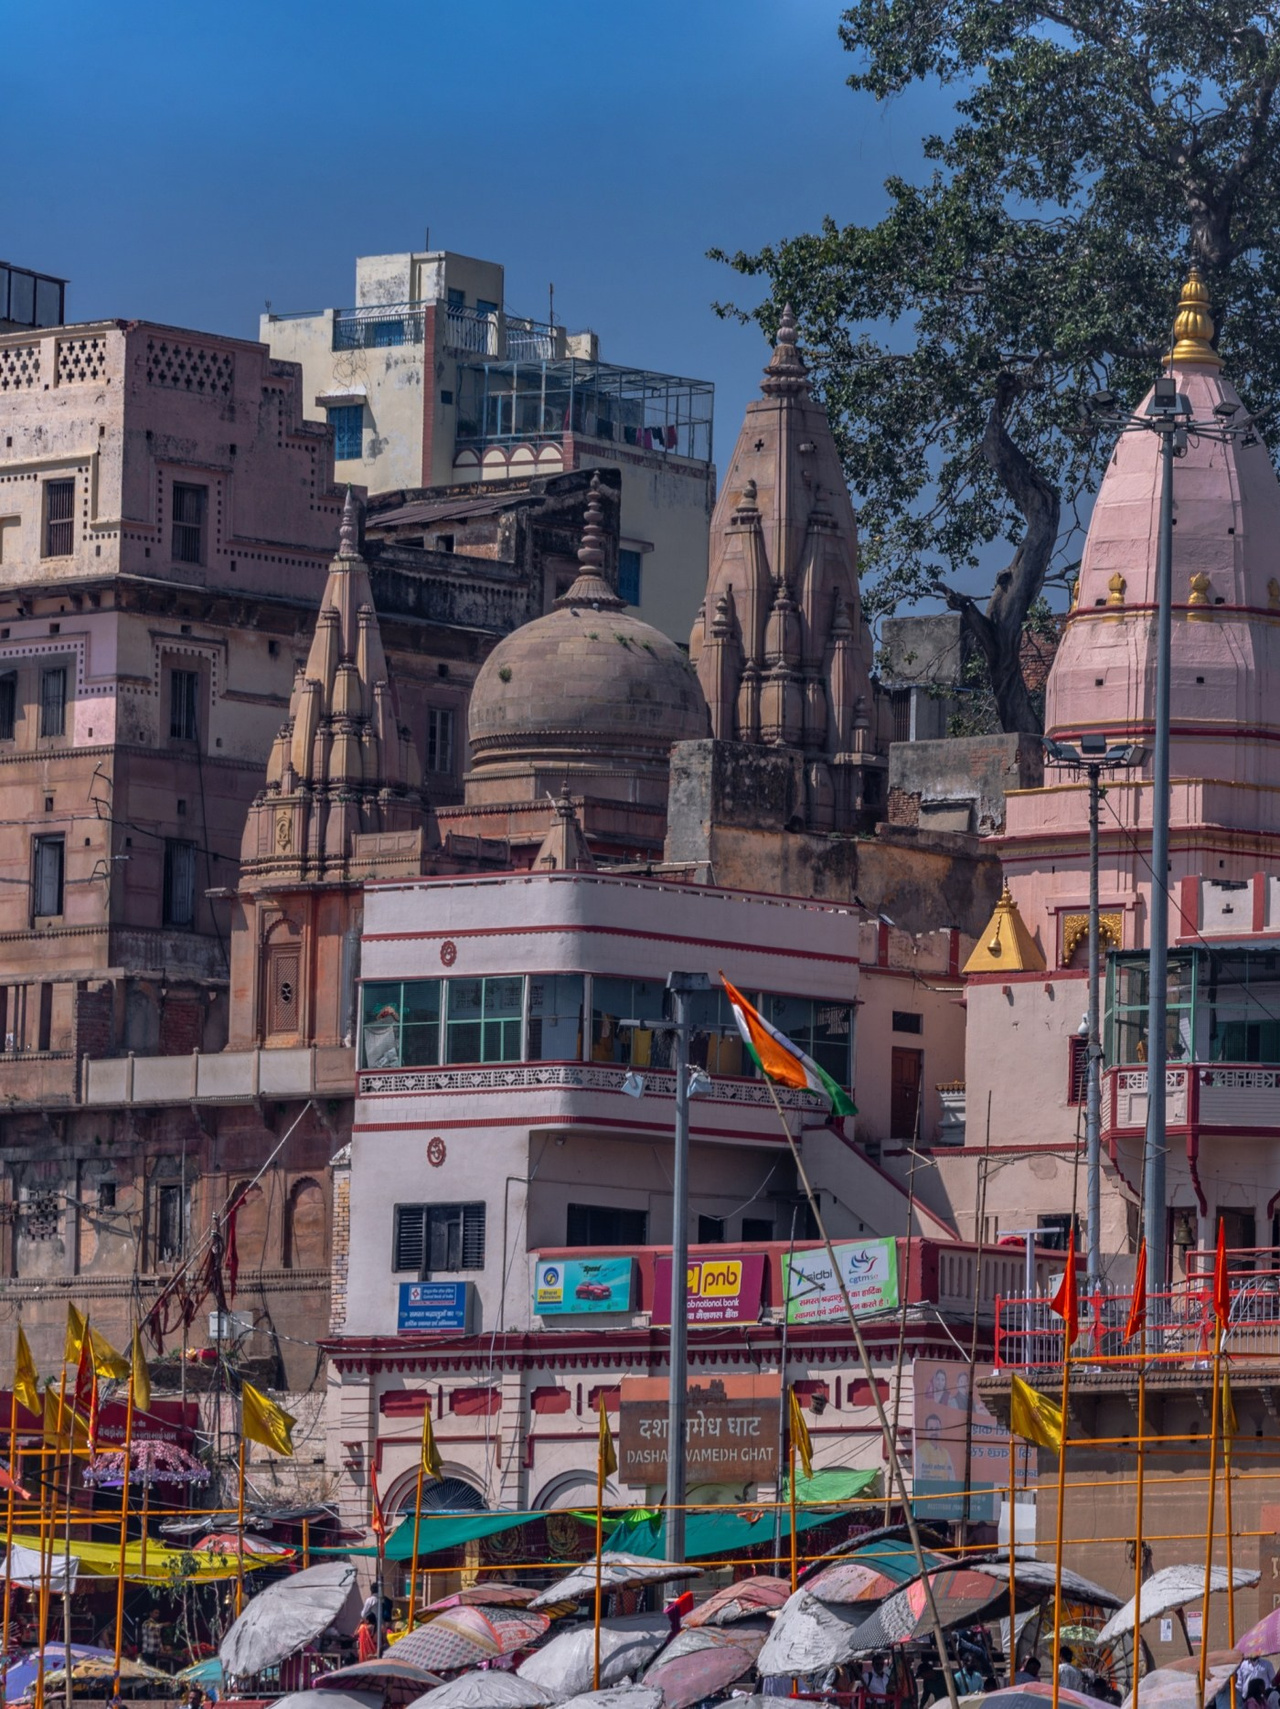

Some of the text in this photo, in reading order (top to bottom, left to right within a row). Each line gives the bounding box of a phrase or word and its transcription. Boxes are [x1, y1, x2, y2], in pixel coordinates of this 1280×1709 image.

[703, 1265, 738, 1292] pnb
[807, 1269, 833, 1281] sidbi
[848, 1273, 879, 1284] cgtmse
[695, 1299, 722, 1309] national
[723, 1298, 739, 1308] bank
[727, 1416, 761, 1437] घाट
[627, 1447, 774, 1464] DASHAVAMEDH GHAT
